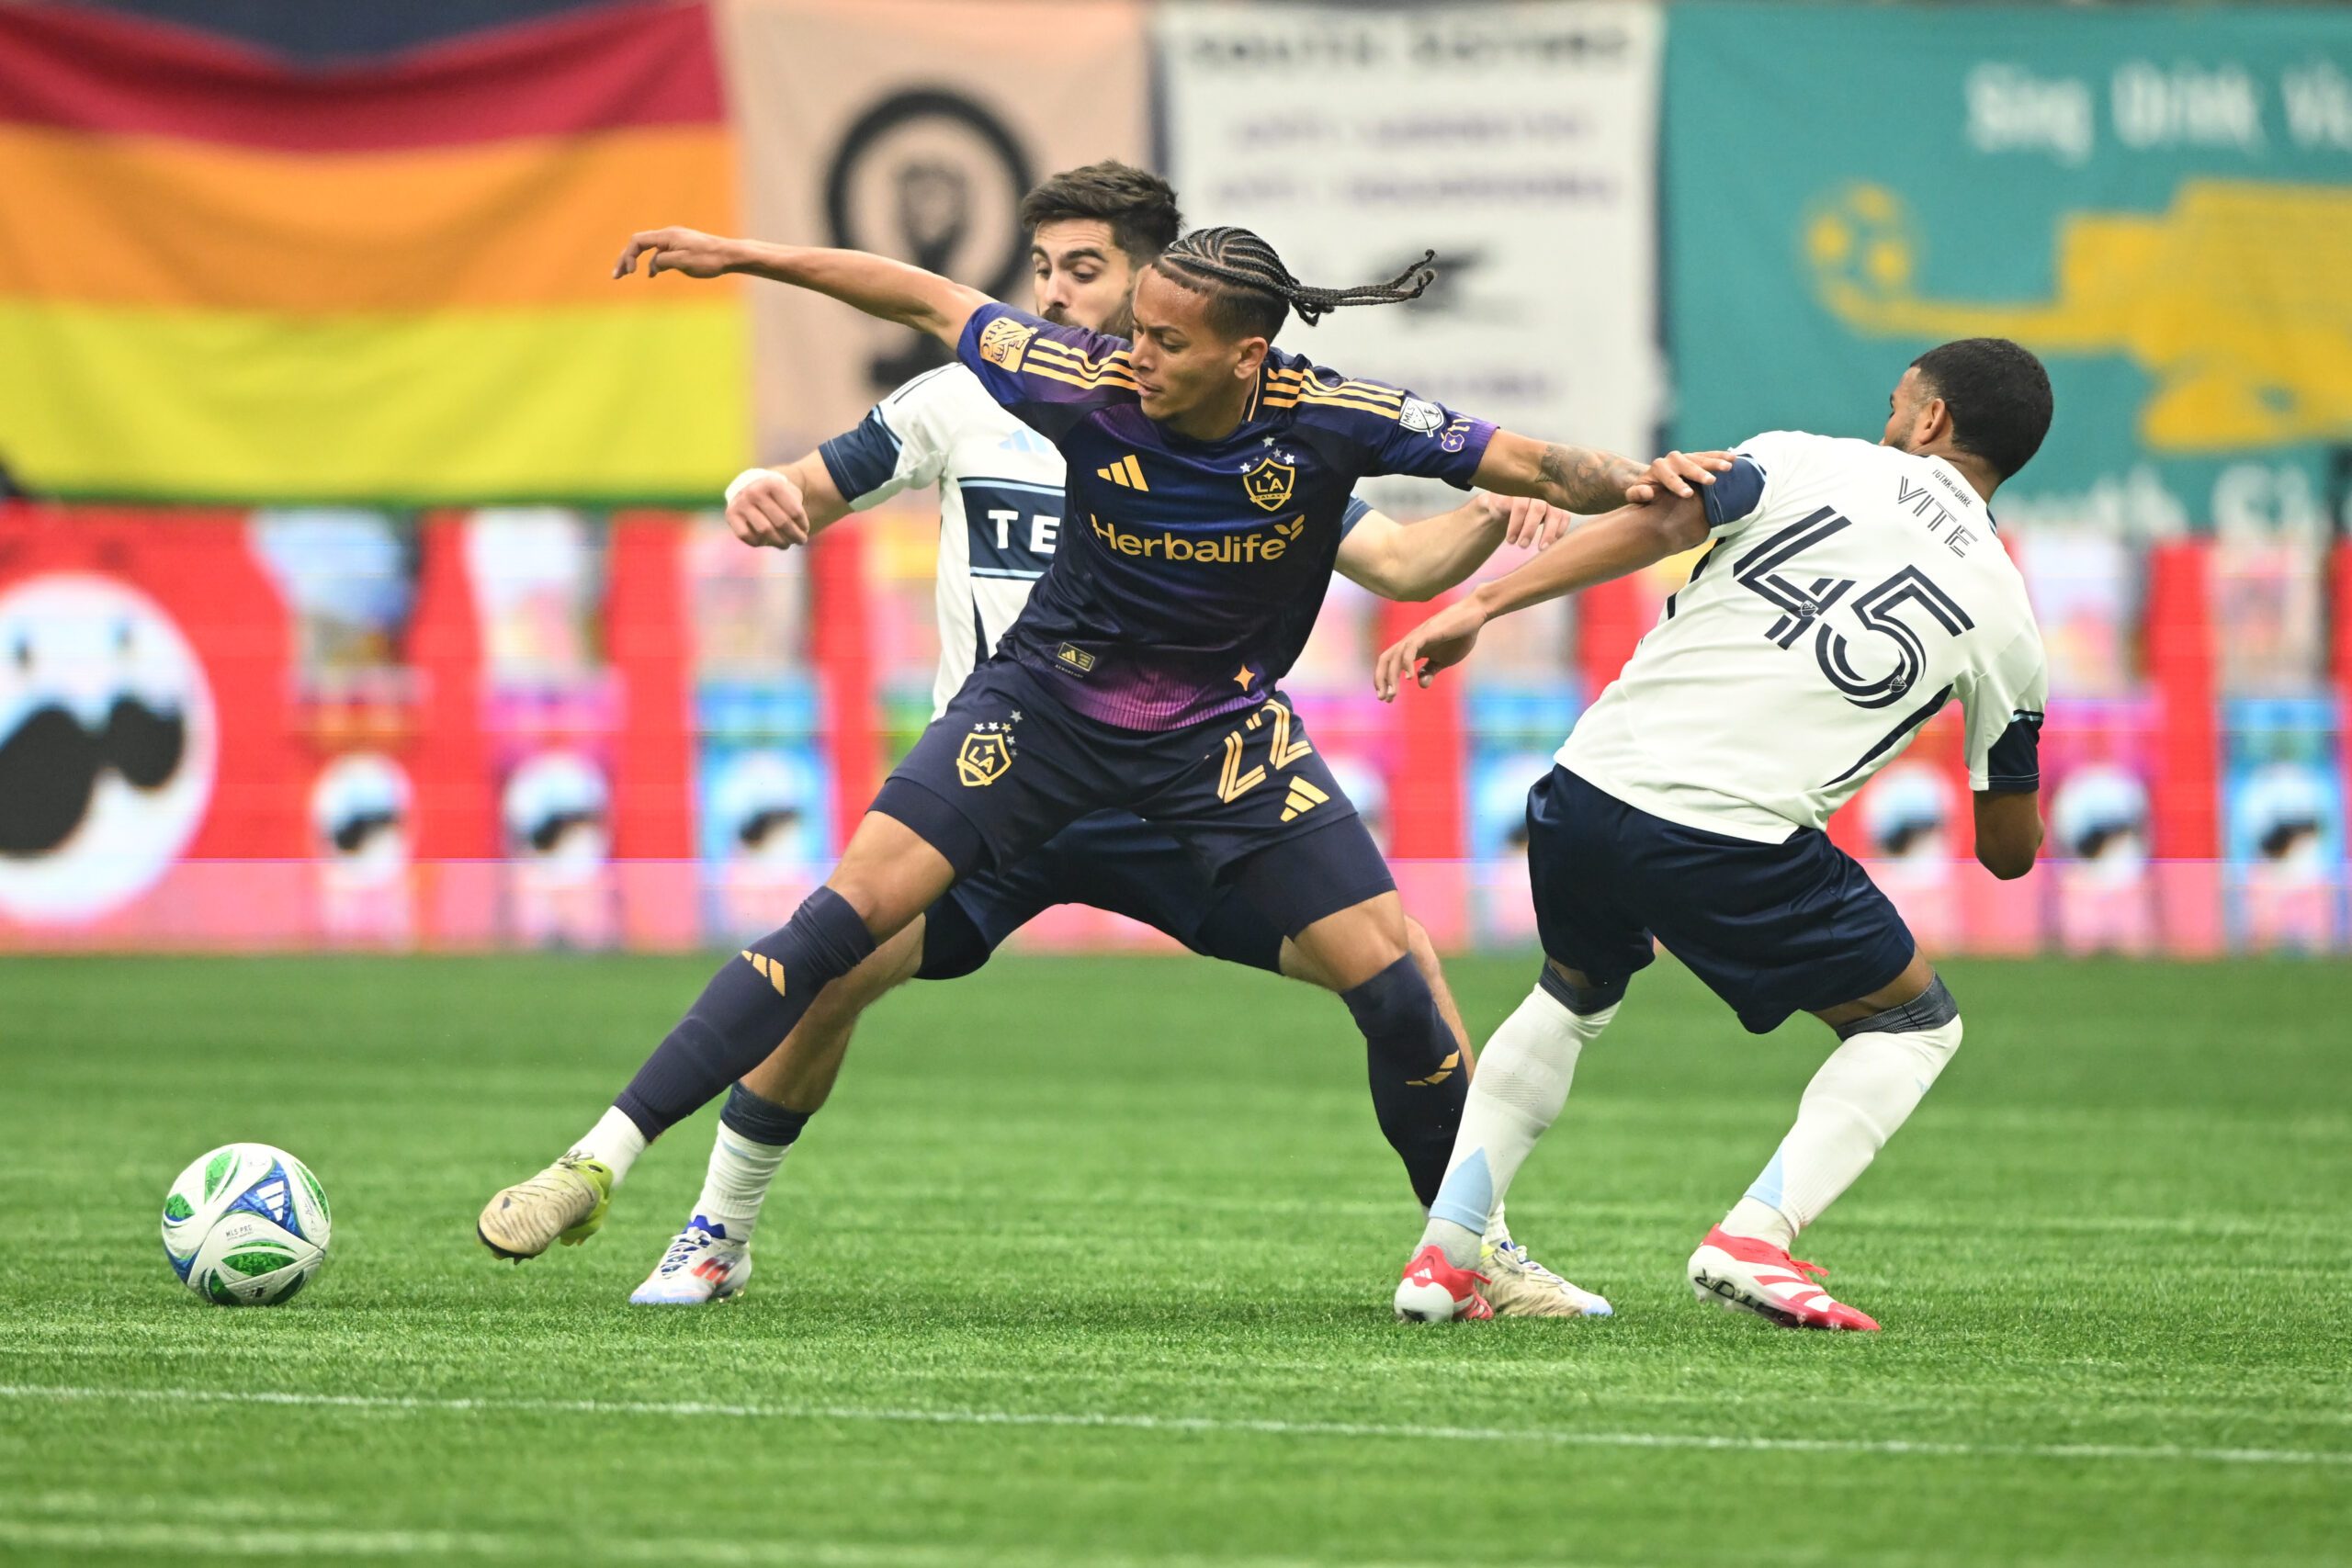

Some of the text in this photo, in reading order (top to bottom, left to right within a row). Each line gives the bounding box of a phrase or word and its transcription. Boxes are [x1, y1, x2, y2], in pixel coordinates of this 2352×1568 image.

[981, 320, 1007, 358] RBC
[1403, 406, 1416, 423] MLS
[1256, 478, 1284, 492] LA
[1091, 513, 1287, 563] Herbalife
[1898, 476, 1978, 558] VITE
[1733, 505, 1975, 709] 45
[967, 746, 994, 774] LA
[1217, 698, 1313, 804] 22
